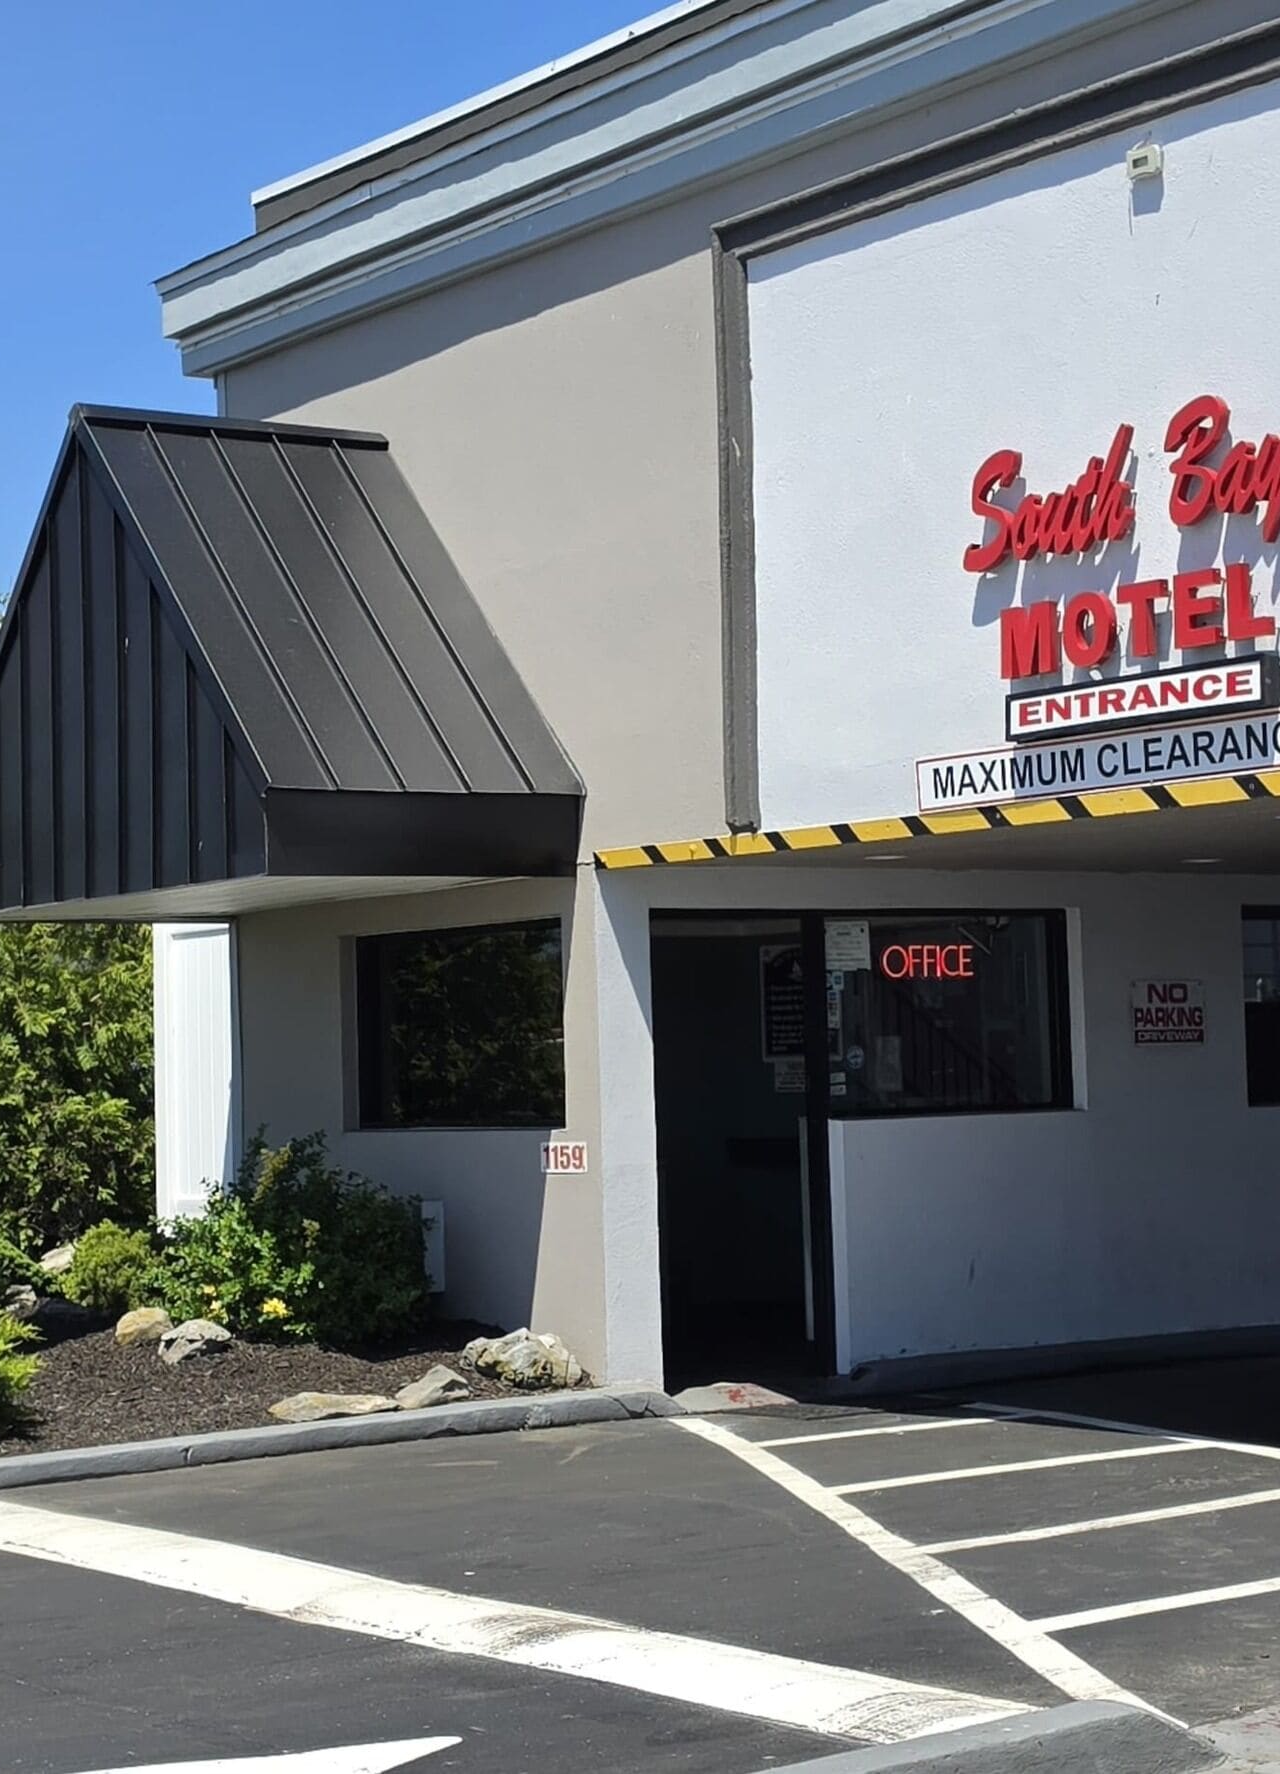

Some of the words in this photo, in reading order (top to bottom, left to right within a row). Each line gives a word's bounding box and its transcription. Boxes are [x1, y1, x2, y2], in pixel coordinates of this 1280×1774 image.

[963, 424, 1135, 573] South
[1001, 562, 1275, 679] MOTEL
[1018, 669, 1253, 727] ENTRANCE
[932, 749, 1085, 800] MAXIMUM
[882, 945, 974, 977] OFFICE
[1147, 983, 1188, 1003] NO
[1135, 1006, 1203, 1028] PARKING
[543, 1145, 584, 1170] 1159
